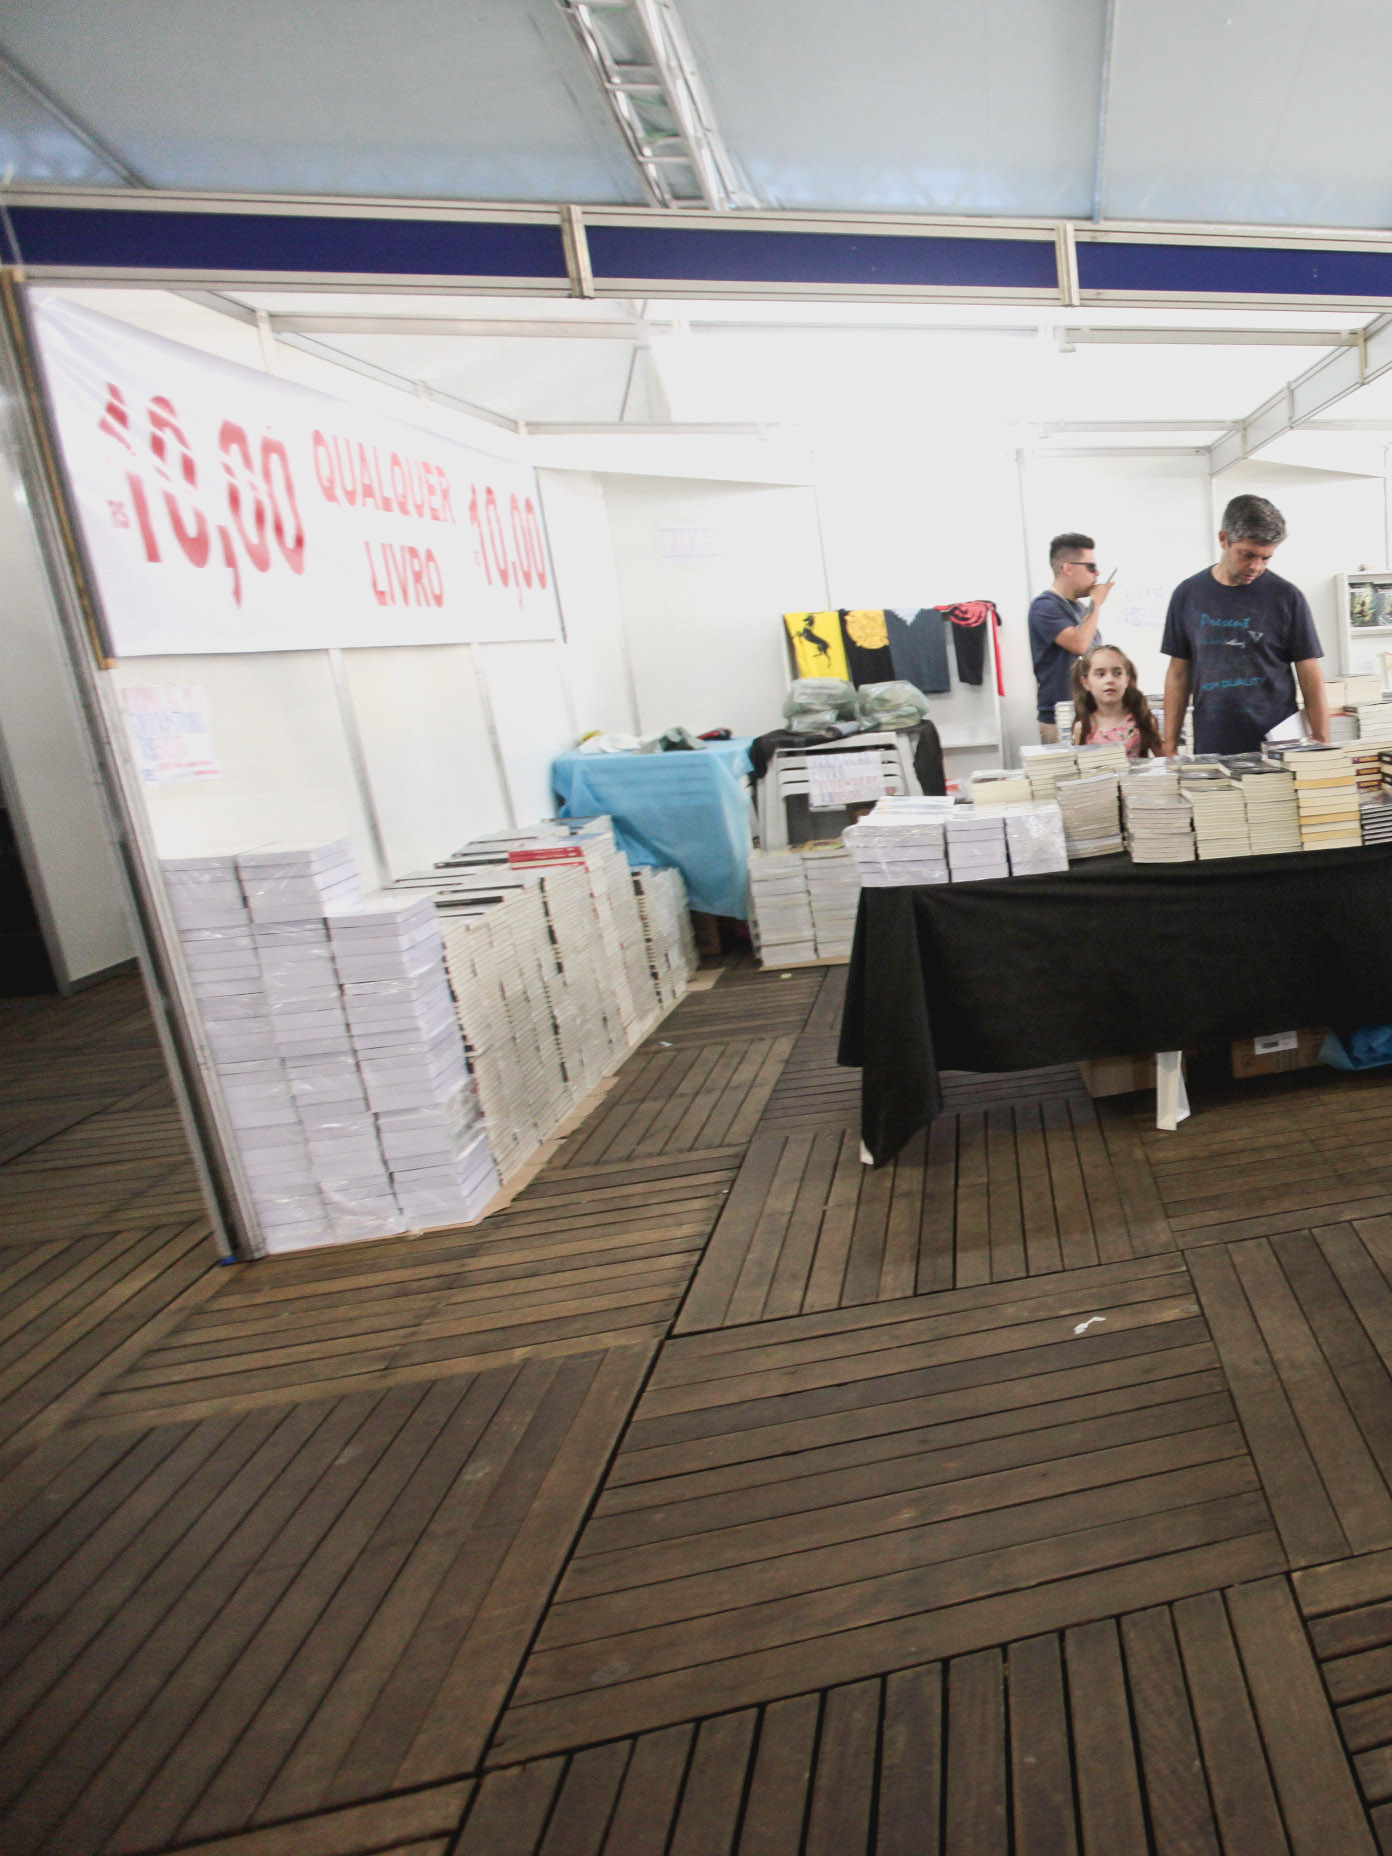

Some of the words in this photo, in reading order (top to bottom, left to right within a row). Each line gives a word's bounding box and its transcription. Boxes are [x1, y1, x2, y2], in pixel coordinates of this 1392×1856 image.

[98, 381, 305, 609] 10,00
[312, 429, 457, 525] QUALQUER
[363, 540, 445, 608] LIVRO
[468, 482, 548, 611] 10,00
